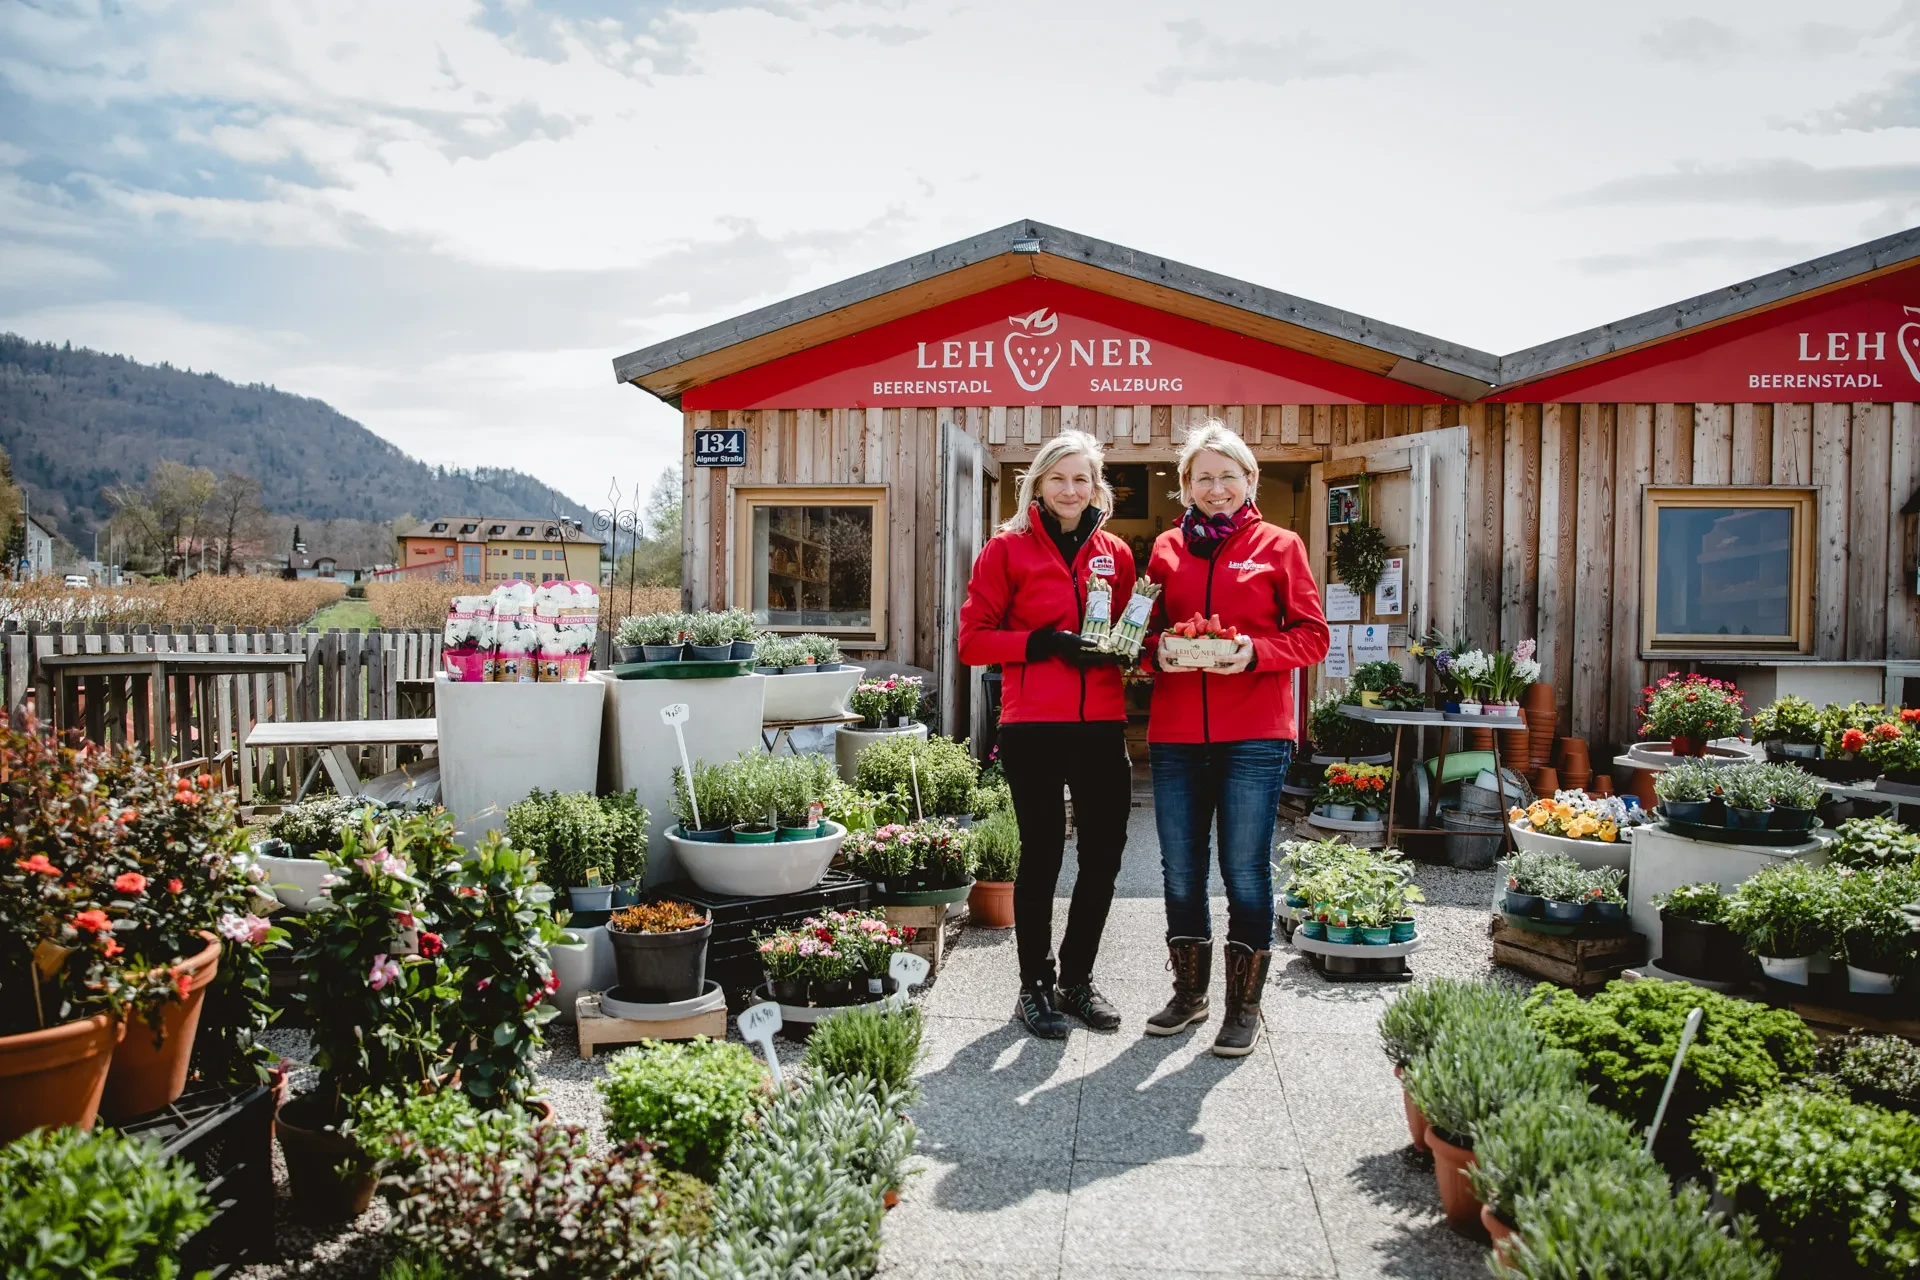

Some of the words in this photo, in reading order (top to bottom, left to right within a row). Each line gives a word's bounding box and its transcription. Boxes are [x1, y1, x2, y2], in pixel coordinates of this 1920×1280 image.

[917, 341, 994, 369] LEH
[1070, 339, 1153, 367] NER
[1798, 332, 1886, 361] LEH
[873, 379, 992, 395] BEERENSTADL
[1090, 377, 1183, 393] SALZBURG
[1748, 373, 1883, 388] BEERENSTADL
[699, 433, 740, 453] 134
